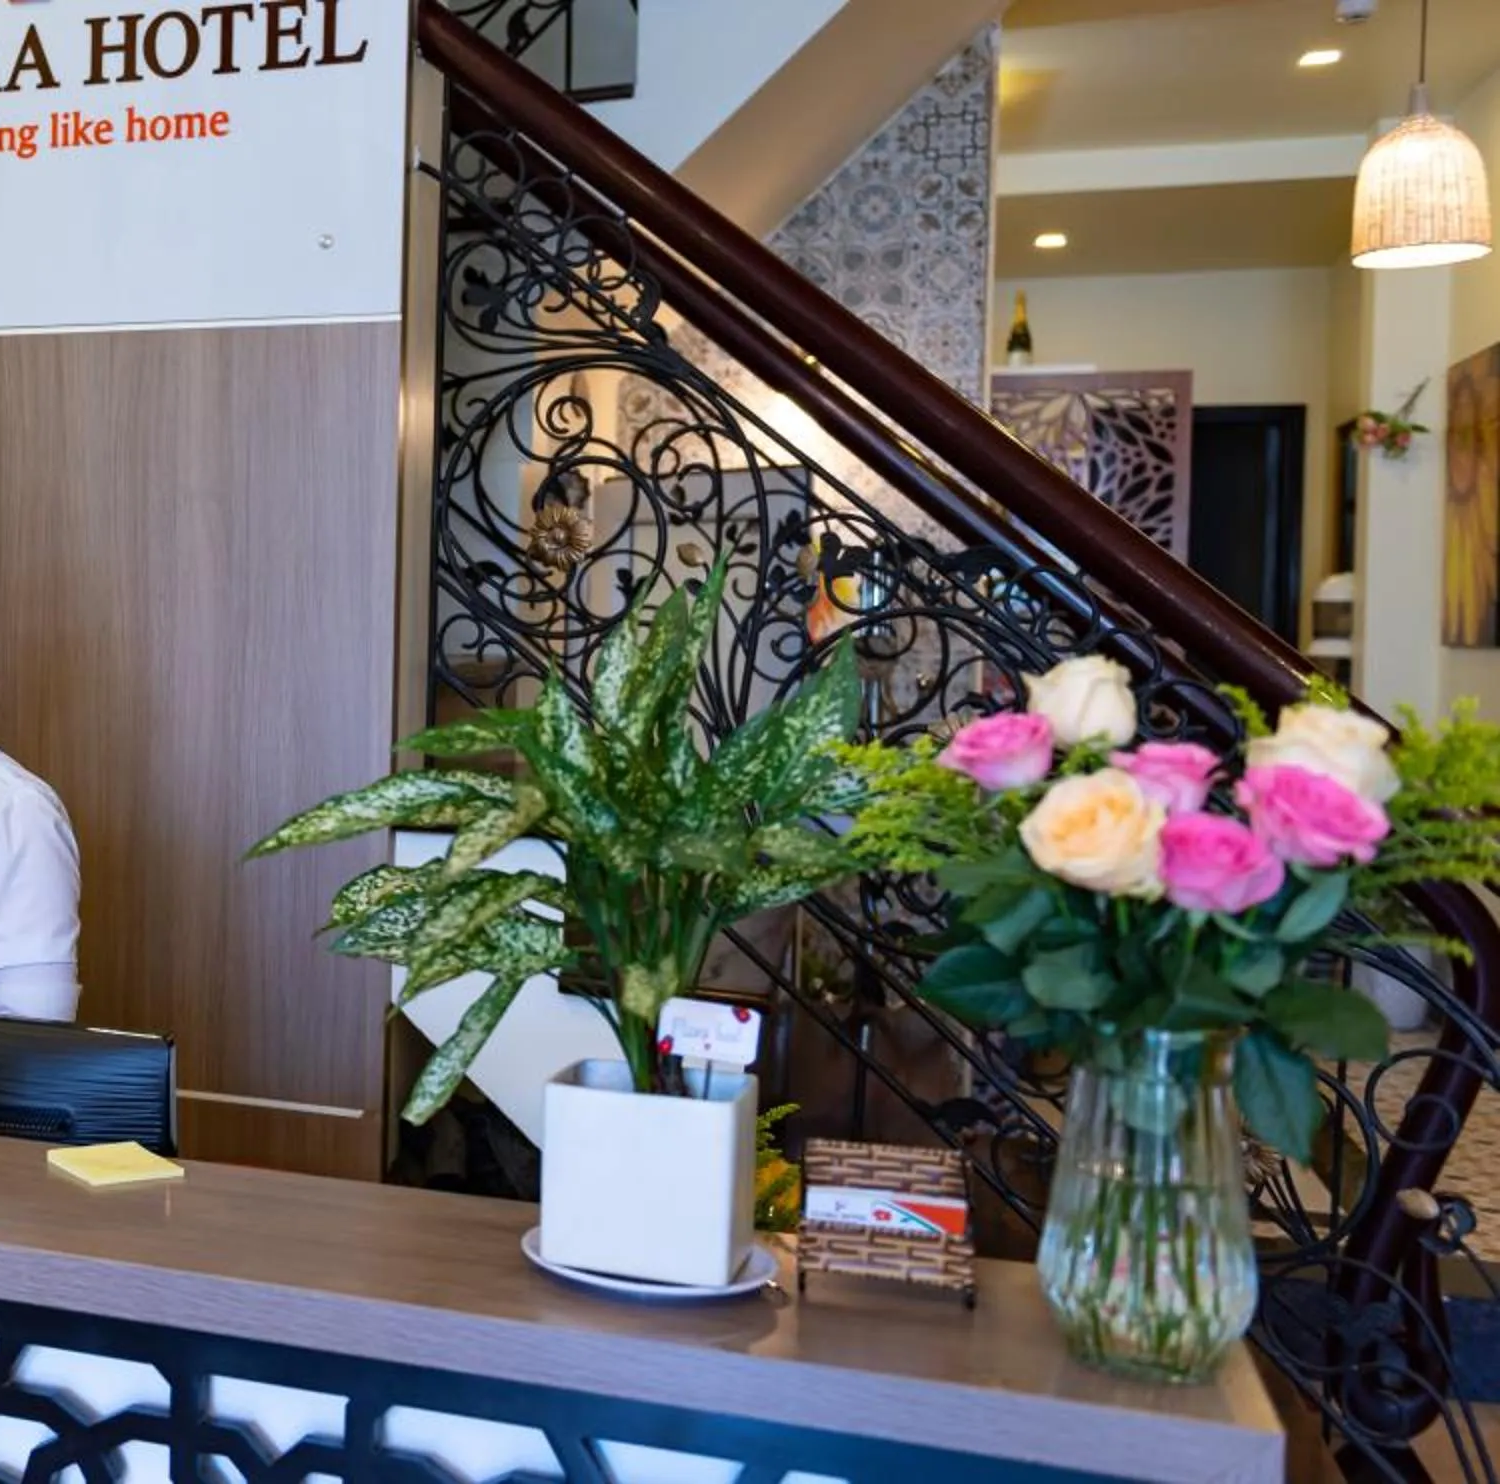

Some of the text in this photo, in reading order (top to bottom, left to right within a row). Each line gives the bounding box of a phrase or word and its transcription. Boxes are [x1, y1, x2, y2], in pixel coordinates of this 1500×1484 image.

[83, 0, 369, 85] HOTEL
[50, 112, 113, 149] like
[126, 107, 230, 142] home
